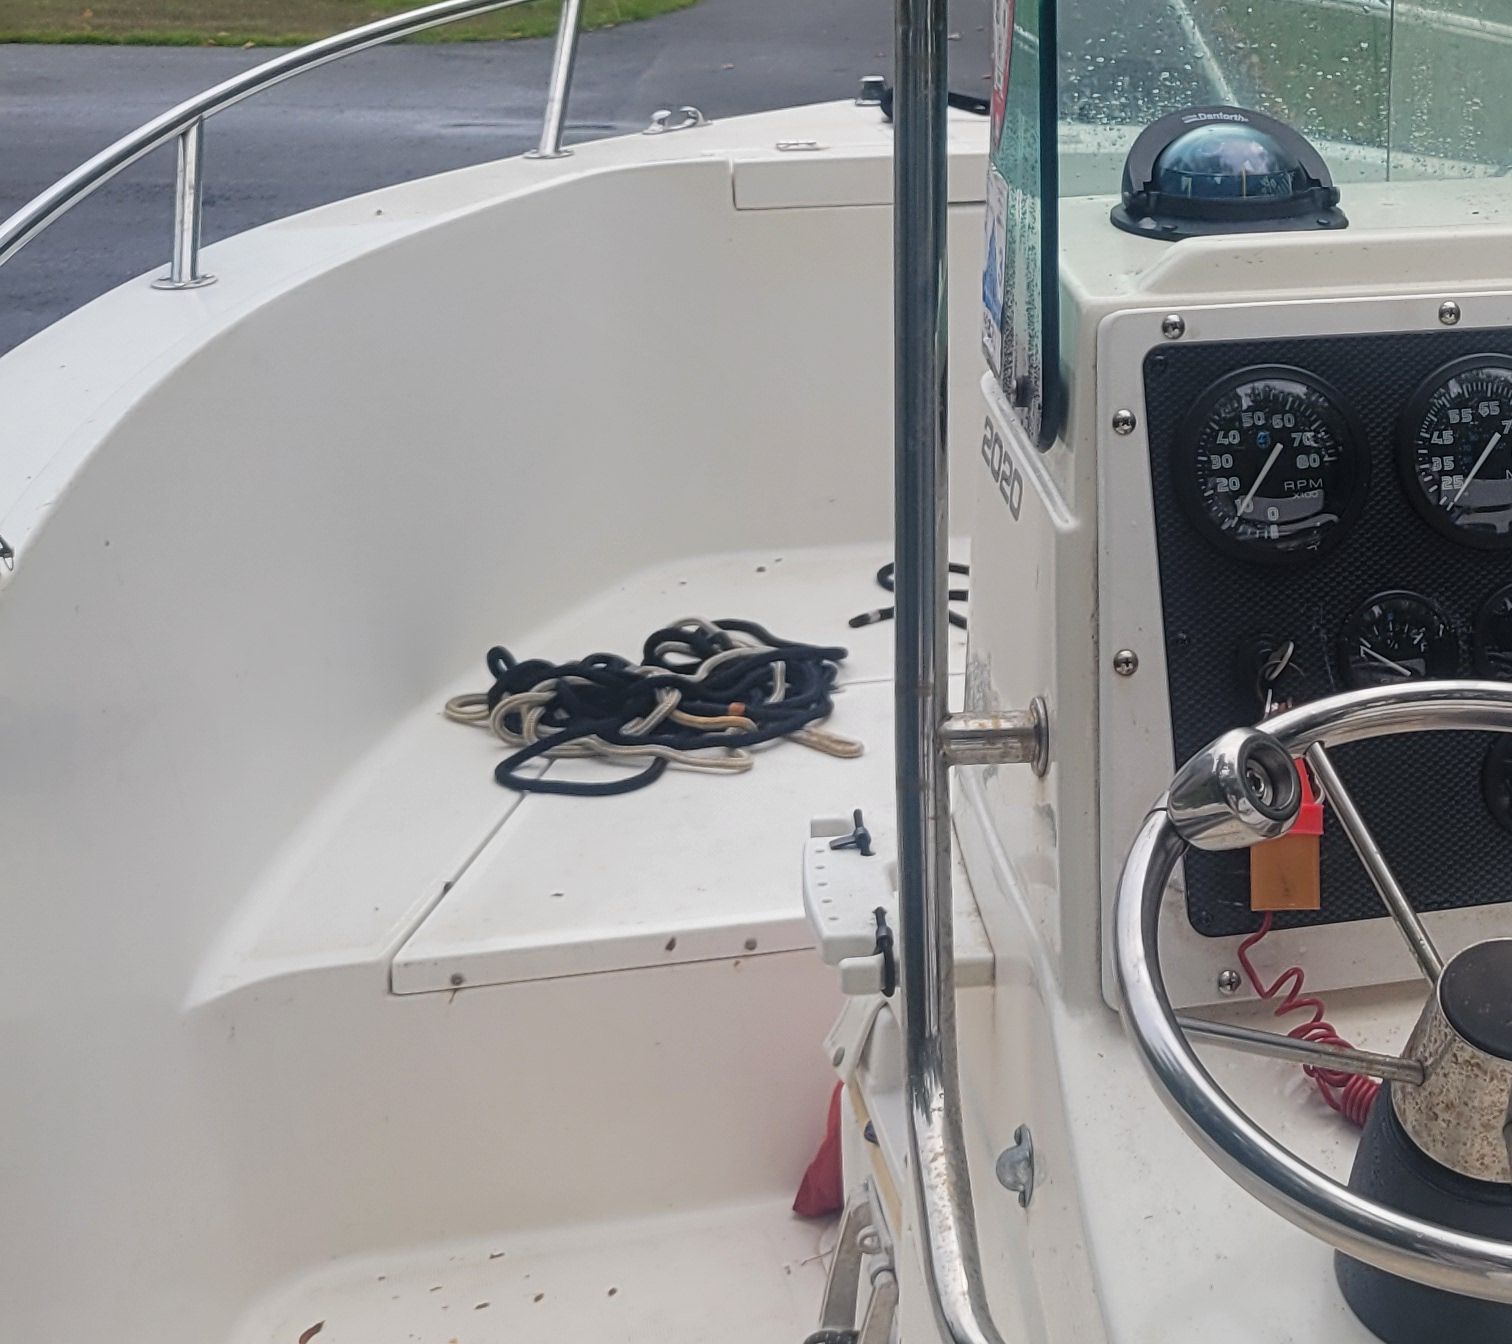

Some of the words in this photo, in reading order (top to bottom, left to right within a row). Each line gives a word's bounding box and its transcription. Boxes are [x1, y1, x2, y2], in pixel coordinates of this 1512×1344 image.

[1198, 112, 1245, 122] Danforth
[1448, 408, 1473, 423] 55
[1478, 401, 1500, 416] 65
[1241, 412, 1265, 427] 50
[1272, 413, 1295, 428] 60
[1216, 430, 1240, 445] 40
[1291, 431, 1315, 447] 70
[1431, 430, 1454, 445] 45
[981, 415, 1024, 522] 2020
[1210, 454, 1233, 469] 30
[1296, 454, 1320, 468] 80
[1431, 456, 1454, 471] 35
[1216, 477, 1240, 492] 20
[1284, 478, 1323, 491] RPM
[1441, 474, 1464, 490] 25
[1267, 506, 1279, 521] 0
